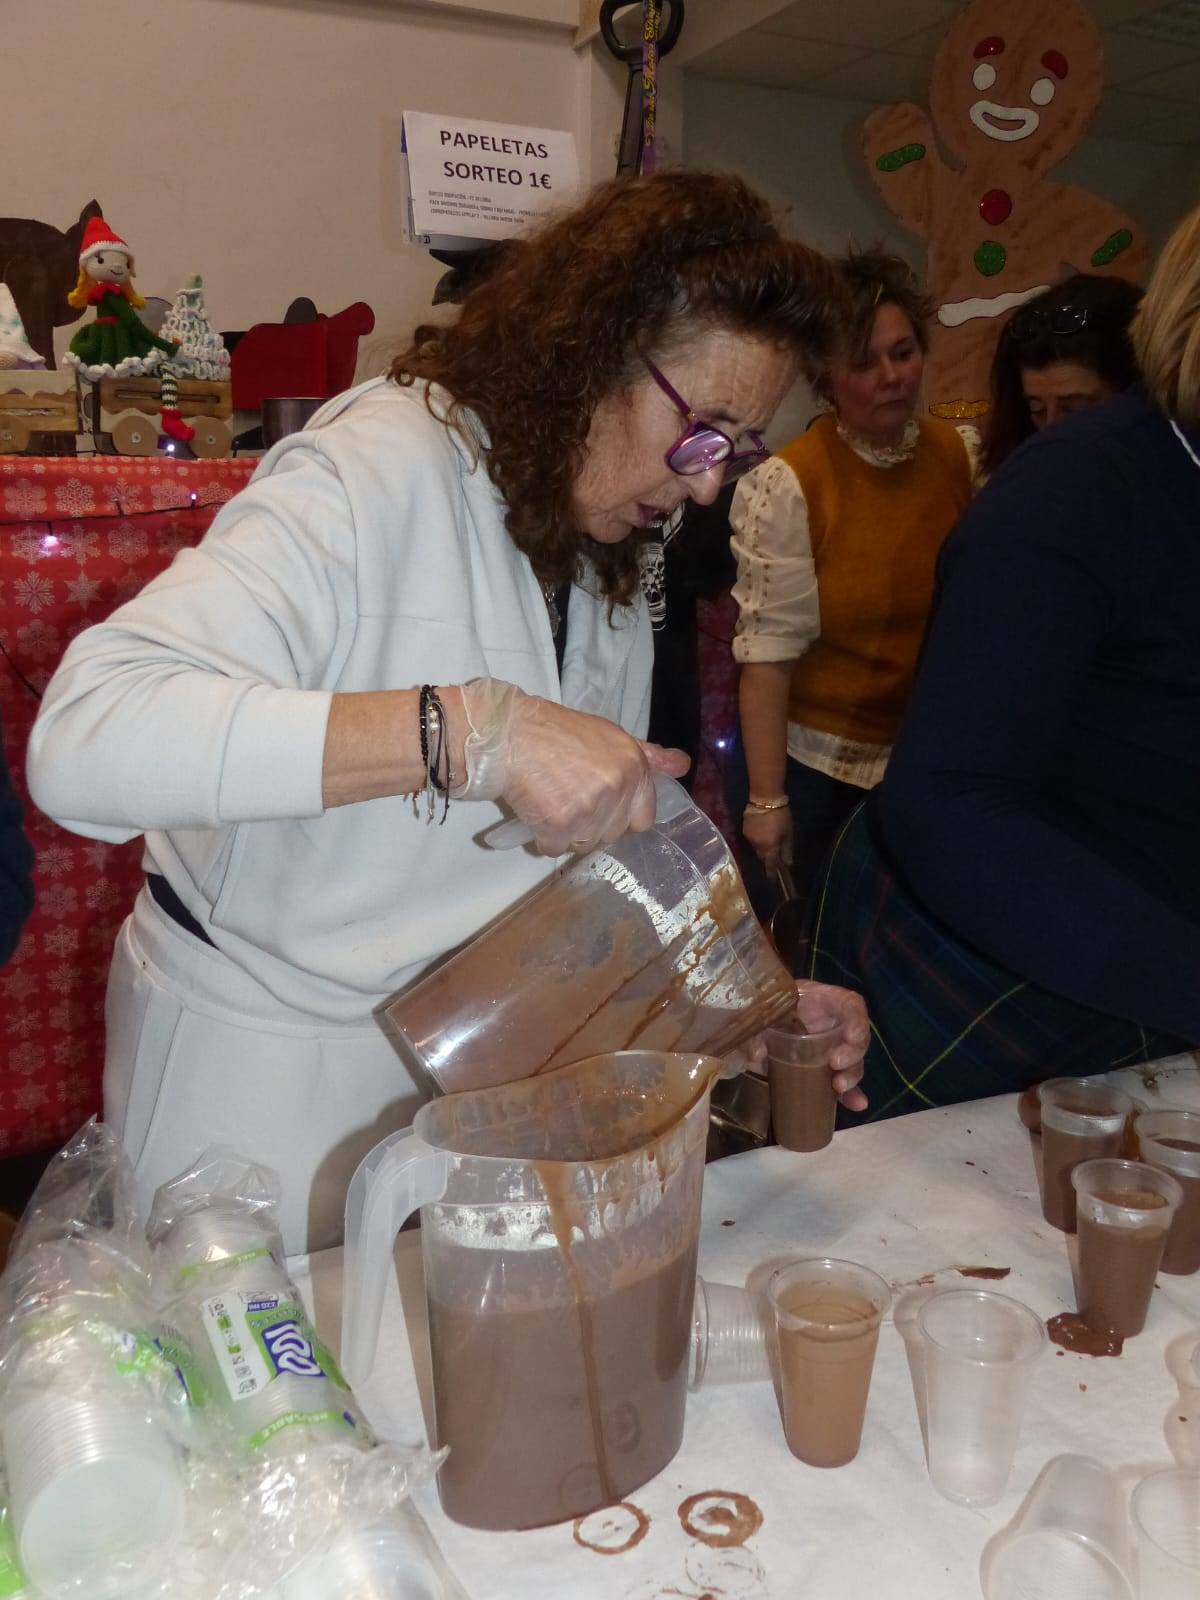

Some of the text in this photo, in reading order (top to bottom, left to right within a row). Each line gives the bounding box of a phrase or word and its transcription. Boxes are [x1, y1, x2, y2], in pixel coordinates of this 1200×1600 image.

[440, 130, 548, 159] PAPELETAS
[443, 161, 552, 190] SORTEO 1€
